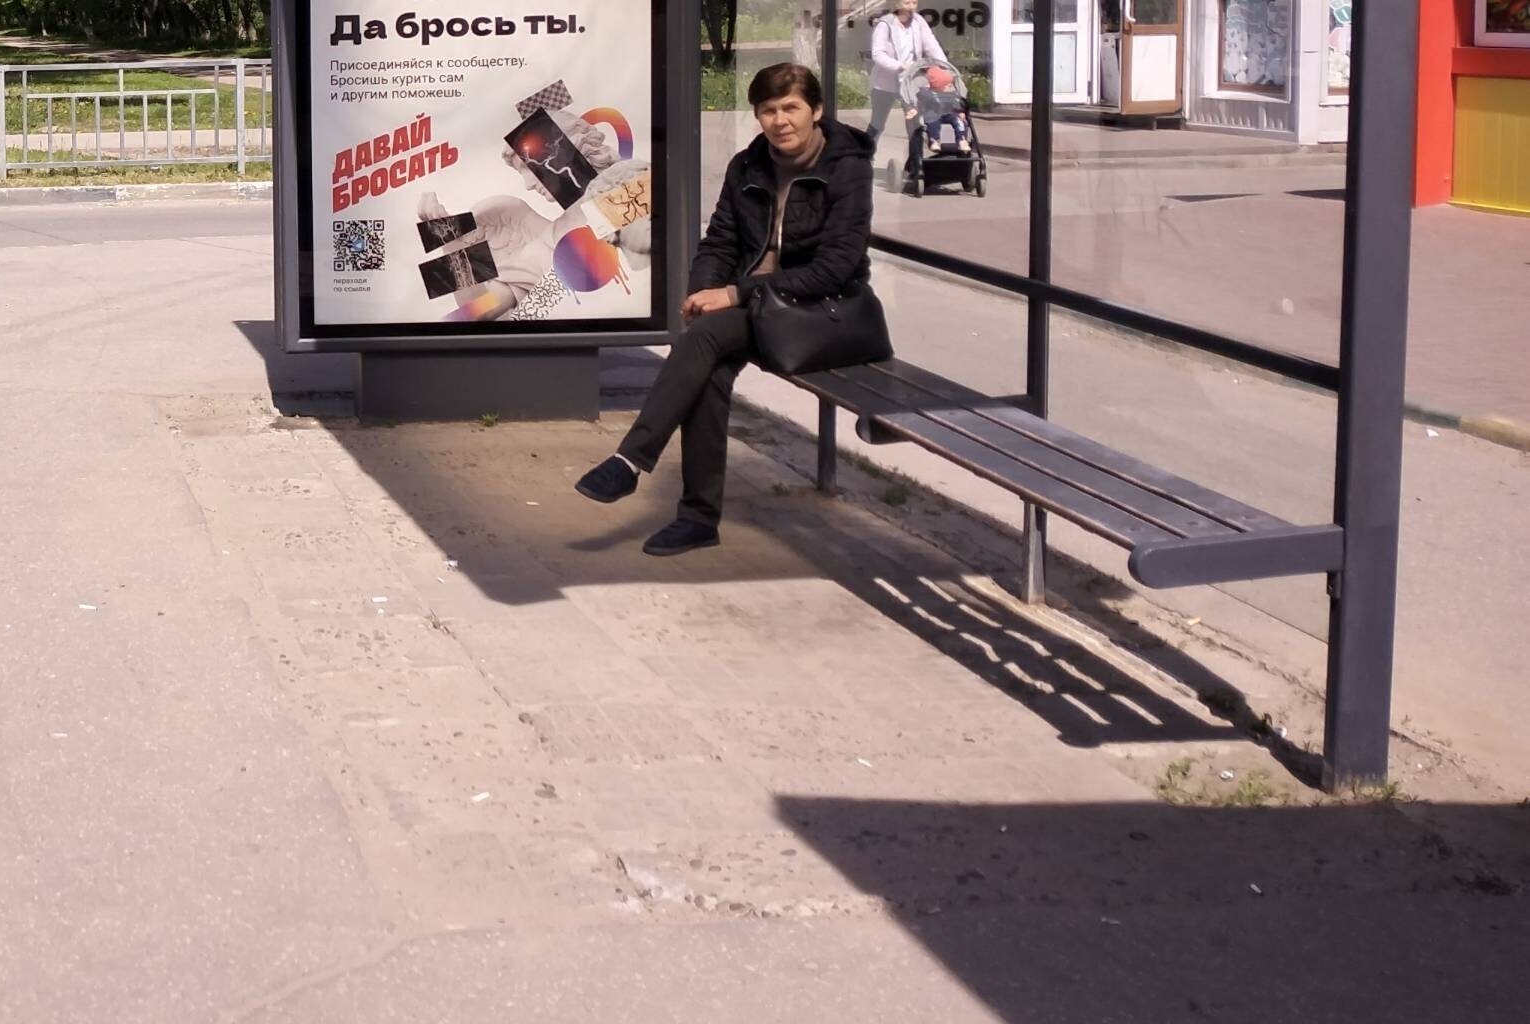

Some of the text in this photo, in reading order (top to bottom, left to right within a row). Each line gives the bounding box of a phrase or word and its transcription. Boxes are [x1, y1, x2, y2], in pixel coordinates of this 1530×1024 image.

[330, 12, 586, 46] Да брось ты.
[330, 55, 528, 73] Присоединяйся к сообществу.
[330, 73, 464, 88] Бросишь курить сам
[330, 88, 465, 103] и другим поможешь.
[332, 112, 432, 185] ДАВАЙ
[332, 141, 459, 214] БРОСАТЬ
